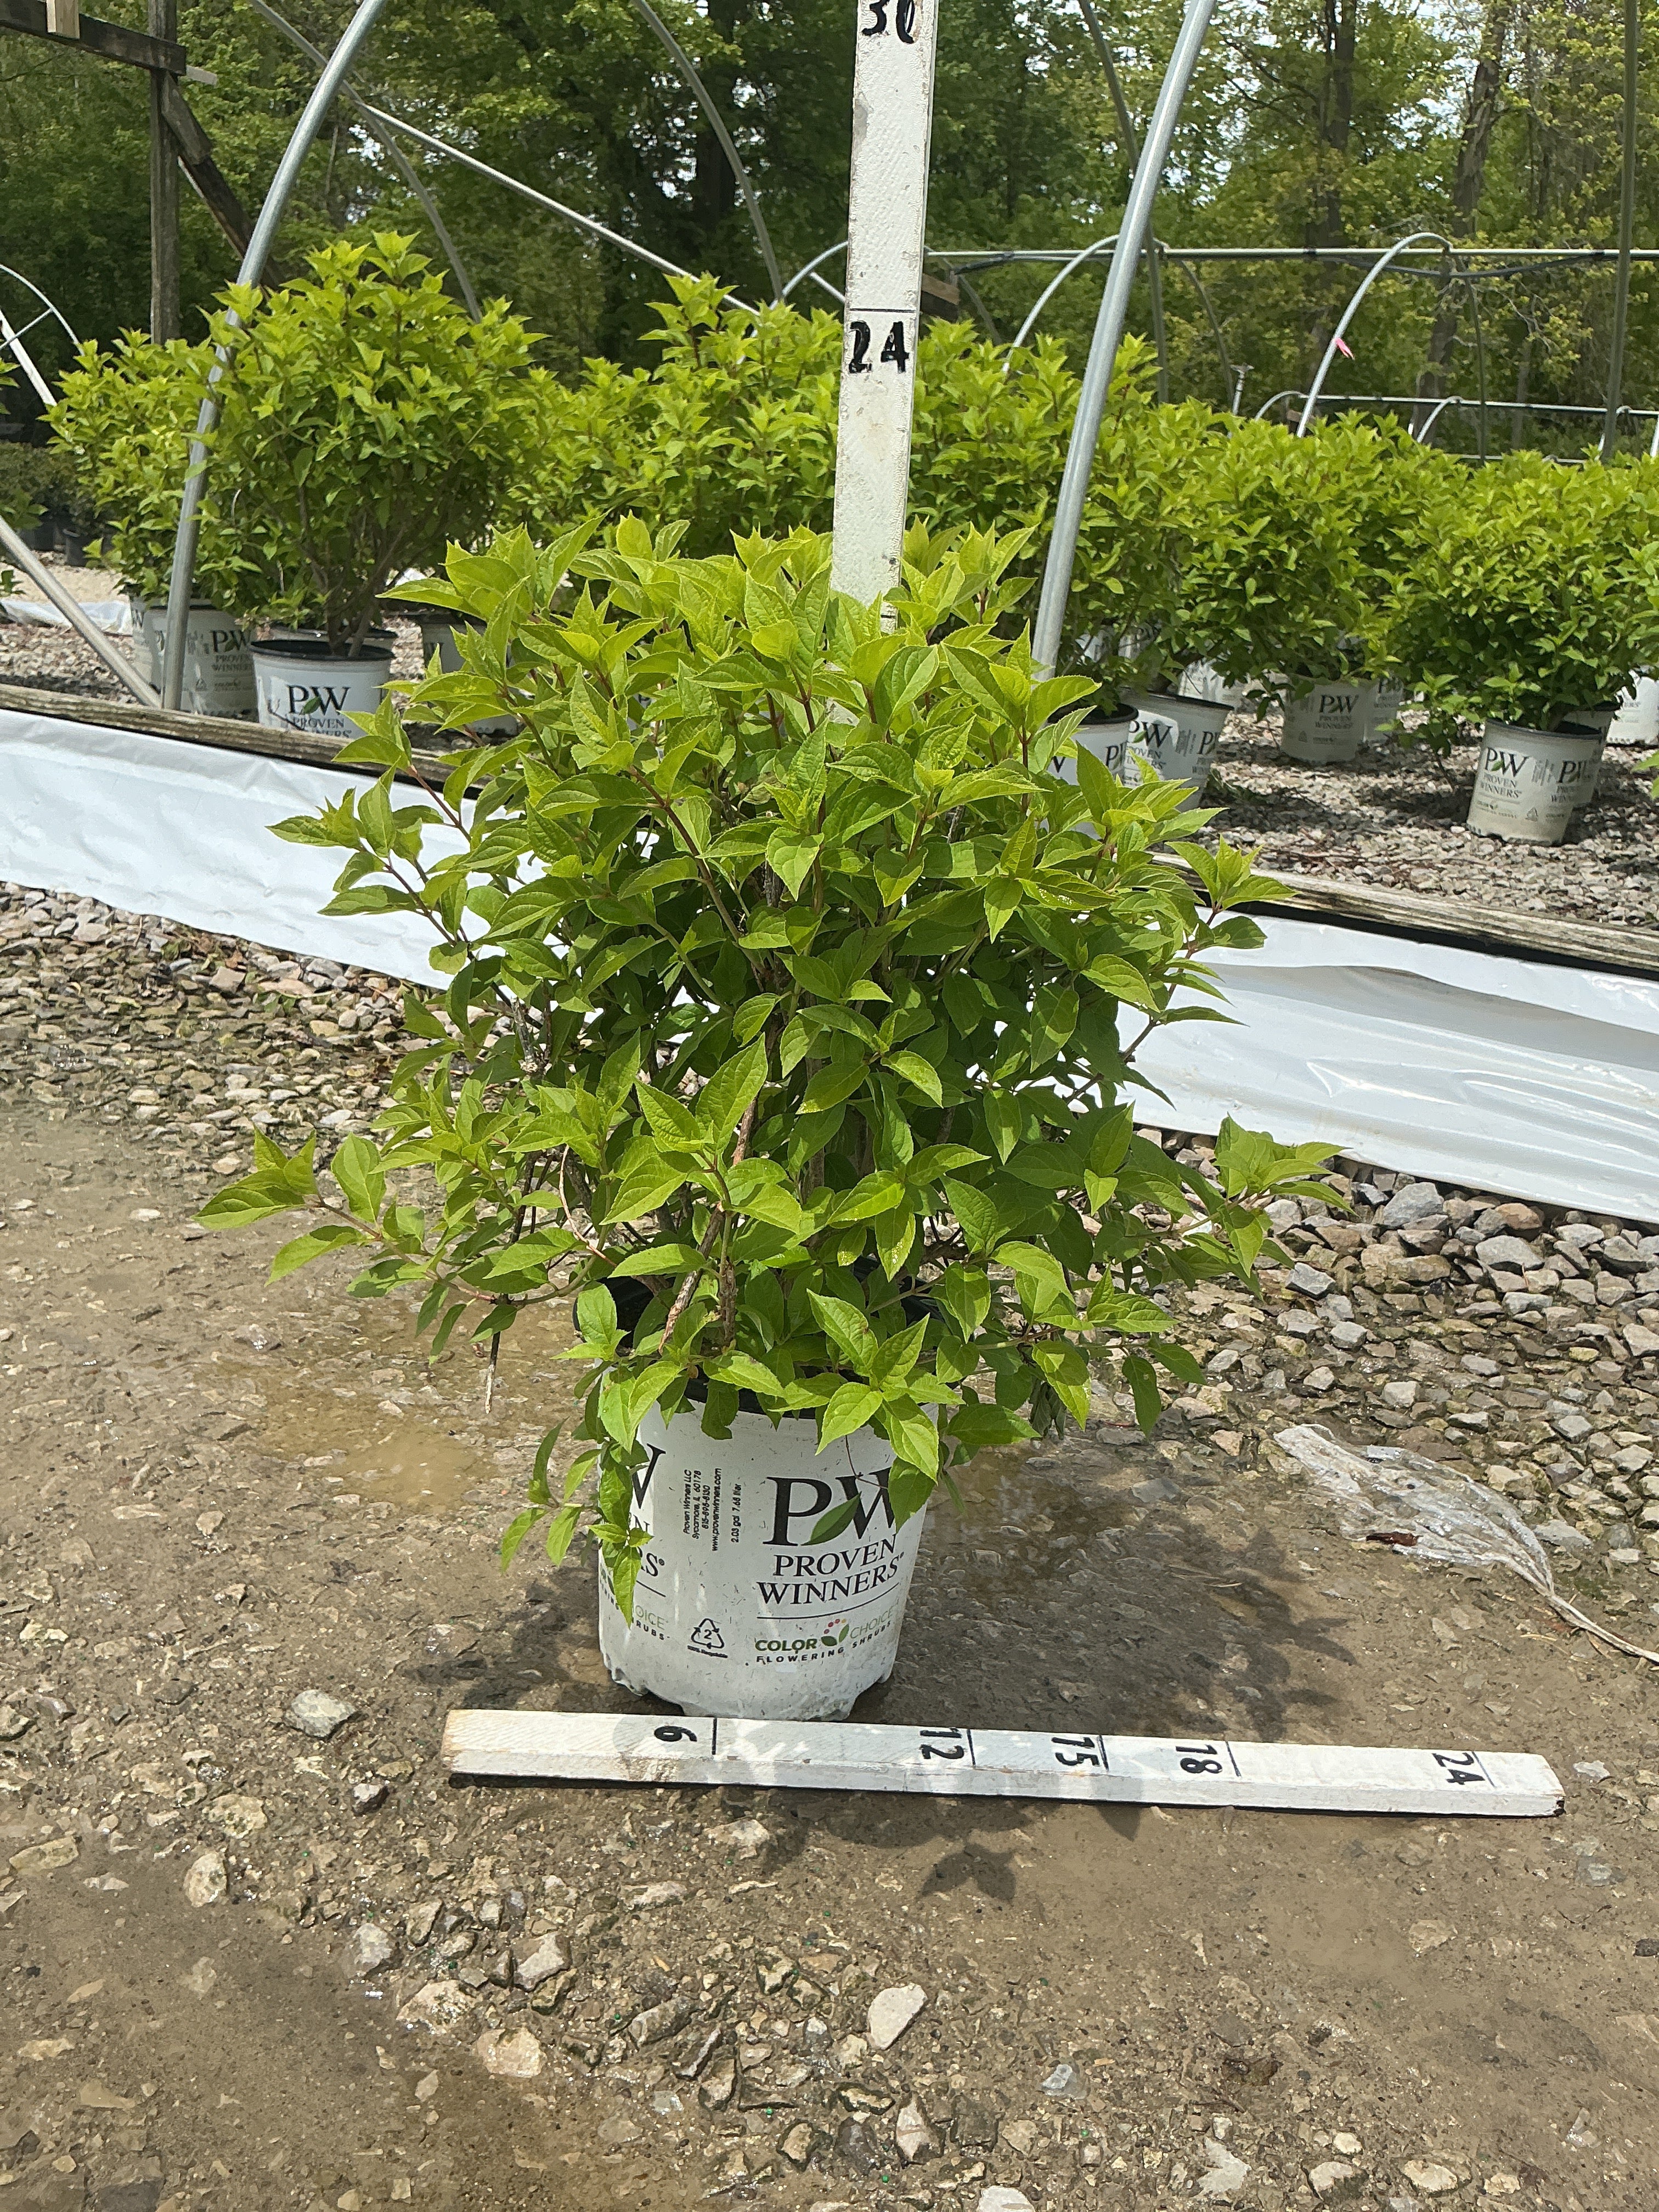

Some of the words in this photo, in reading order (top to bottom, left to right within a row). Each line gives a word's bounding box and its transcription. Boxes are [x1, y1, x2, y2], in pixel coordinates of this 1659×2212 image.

[861, 0, 915, 44] 30
[848, 320, 910, 374] 24
[210, 630, 252, 653] PW
[286, 684, 351, 716] PW
[1319, 694, 1359, 713] PW
[1485, 746, 1531, 778] PW
[684, 1469, 692, 1483] LLC
[693, 1470, 702, 1493] 60178
[683, 1483, 691, 1509] Winners
[712, 1468, 722, 1551] www.provenwinners.com
[732, 1497, 741, 1512] 7.68
[763, 1467, 895, 1546] PW
[732, 1515, 741, 1527] gal
[772, 1534, 896, 1577] PROVEN
[756, 1554, 900, 1605] WINNERS
[635, 1605, 665, 1631] OICE
[755, 1638, 817, 1652] COLOR
[850, 1608, 893, 1639] CHOICE
[703, 1629, 712, 1640] 2
[756, 1646, 844, 1663] FLOWERING
[853, 1621, 891, 1649] SHRUBS
[919, 1726, 966, 1759] 12
[1051, 1736, 1100, 1767] 15
[1175, 1743, 1223, 1774] 18
[1431, 1752, 1486, 1786] 24
